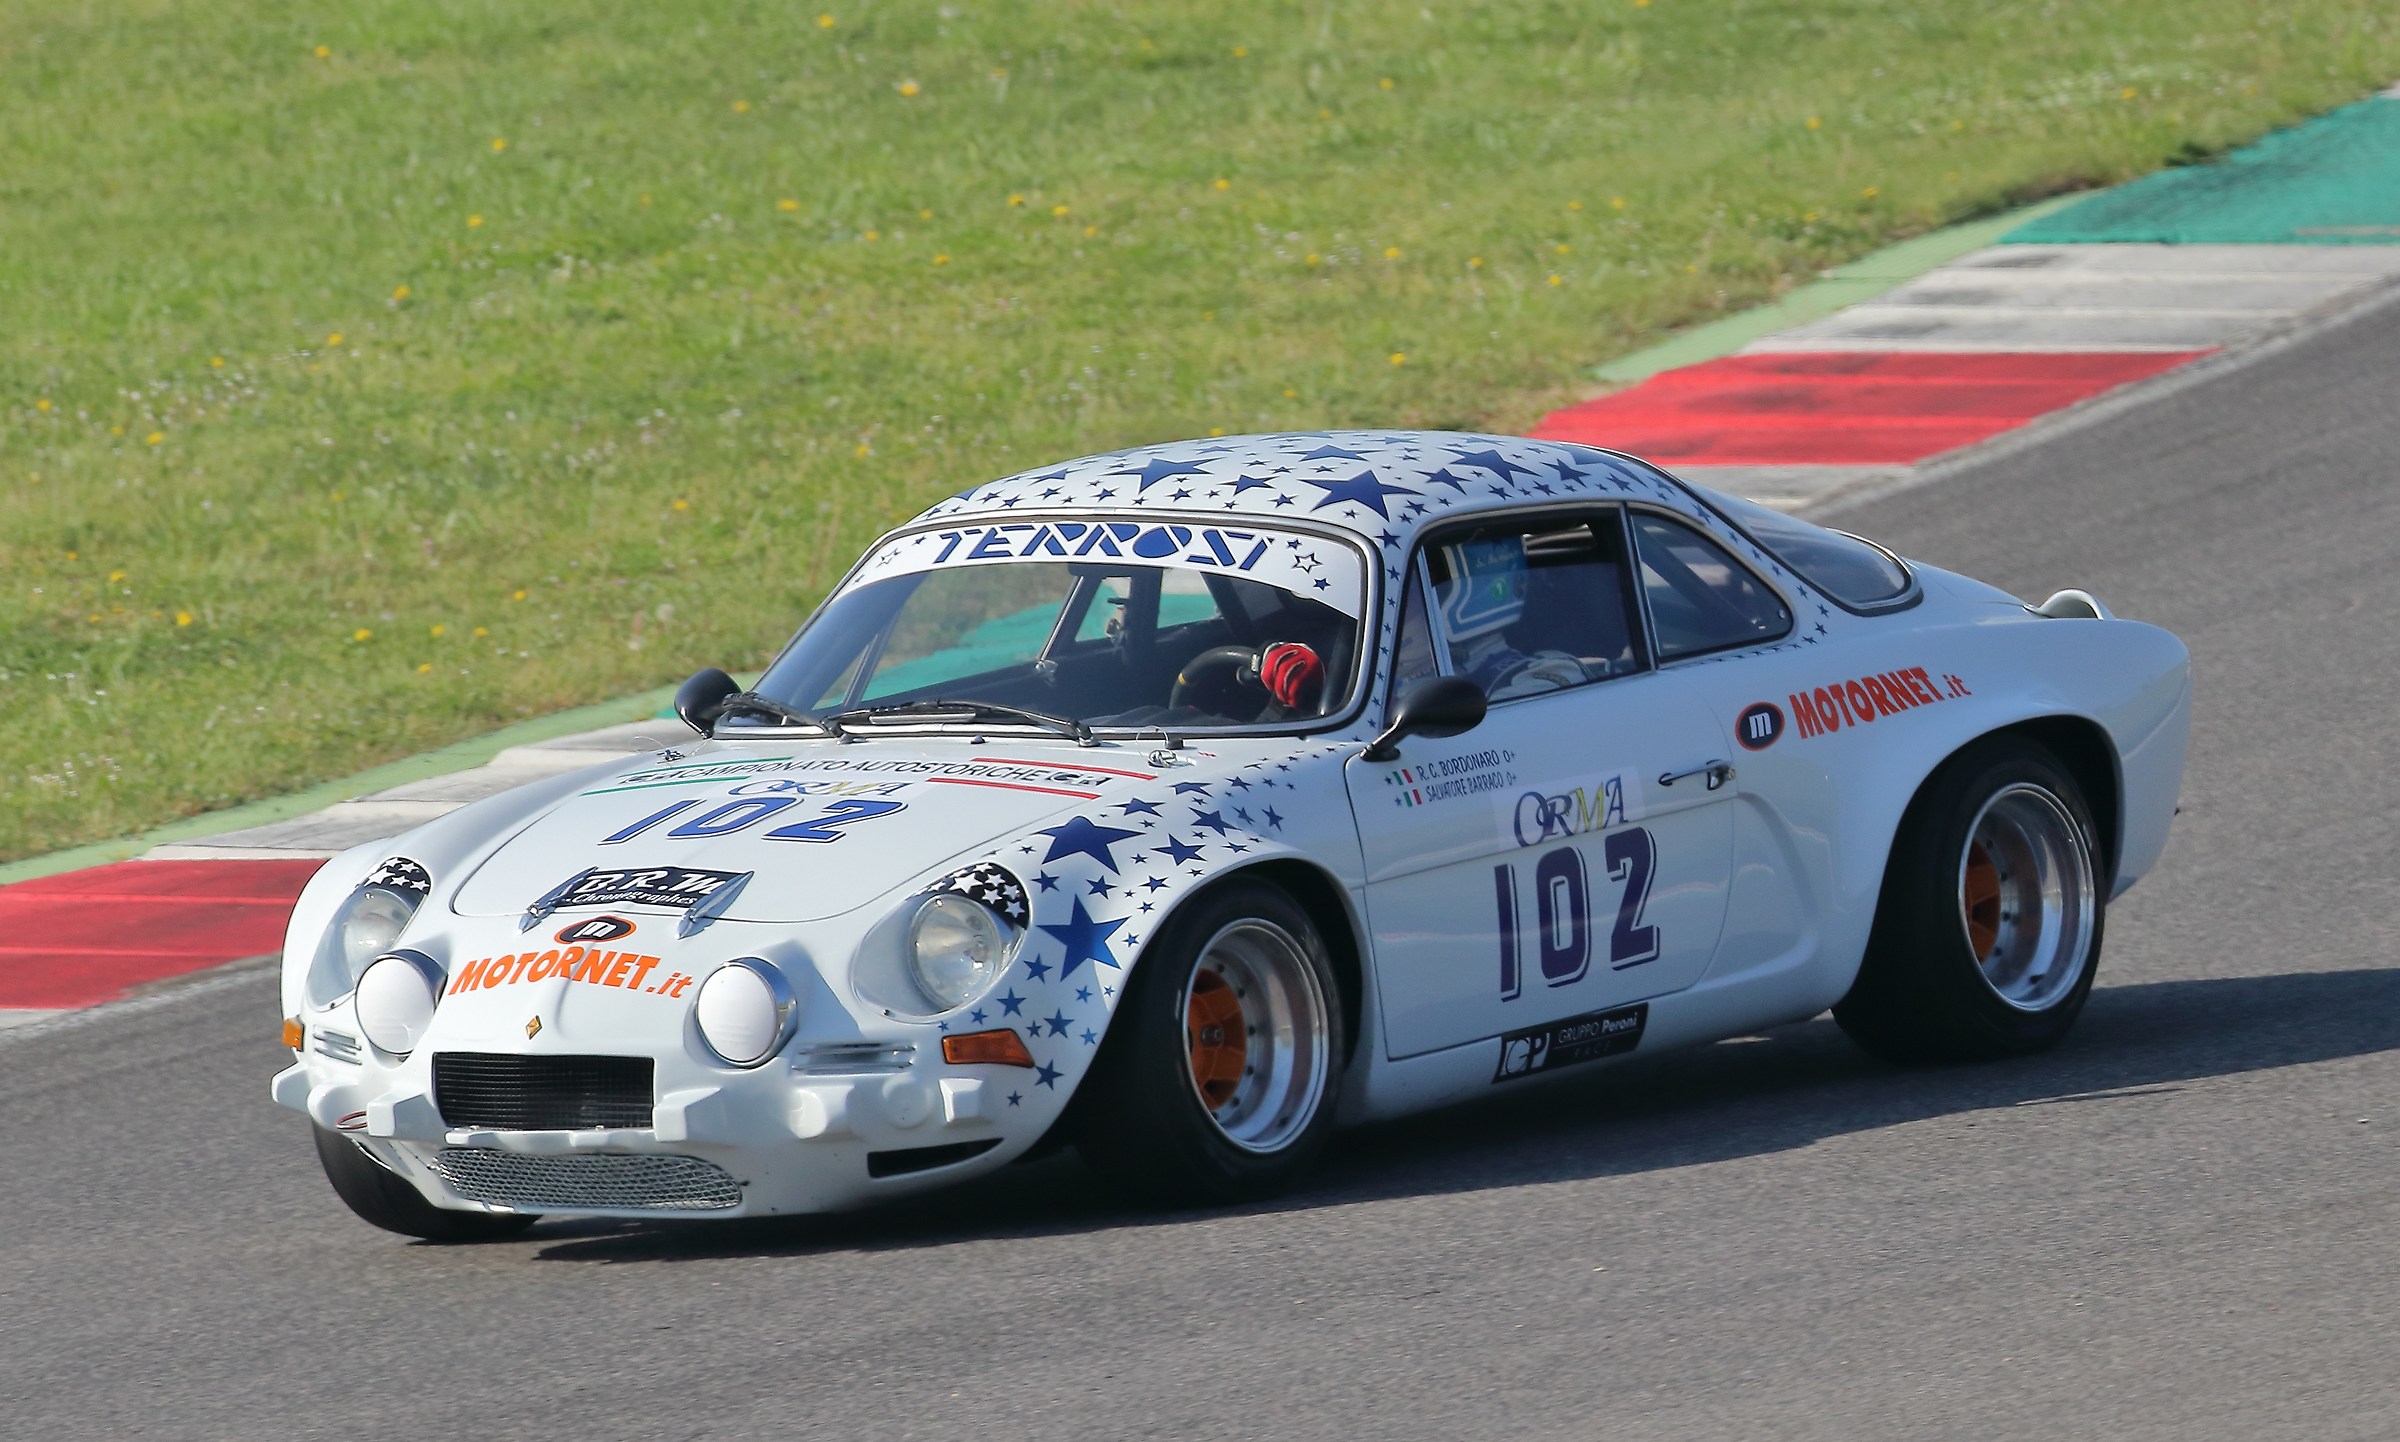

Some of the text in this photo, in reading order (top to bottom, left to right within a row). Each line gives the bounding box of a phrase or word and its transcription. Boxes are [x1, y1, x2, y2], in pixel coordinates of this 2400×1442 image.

[678, 760, 850, 779] CAMPIONATO
[843, 760, 1052, 782] AUTOSTORICHE
[1416, 765, 1430, 781] R.
[1439, 749, 1500, 776] BORDONARO
[1425, 778, 1468, 802] SALVATORE
[598, 797, 910, 846] 102
[1513, 774, 1629, 848] ORMA
[1494, 826, 1660, 1003] 102
[448, 946, 695, 999] MOTORNET.it
[1558, 1012, 1638, 1044] GRUPPO Peroni
